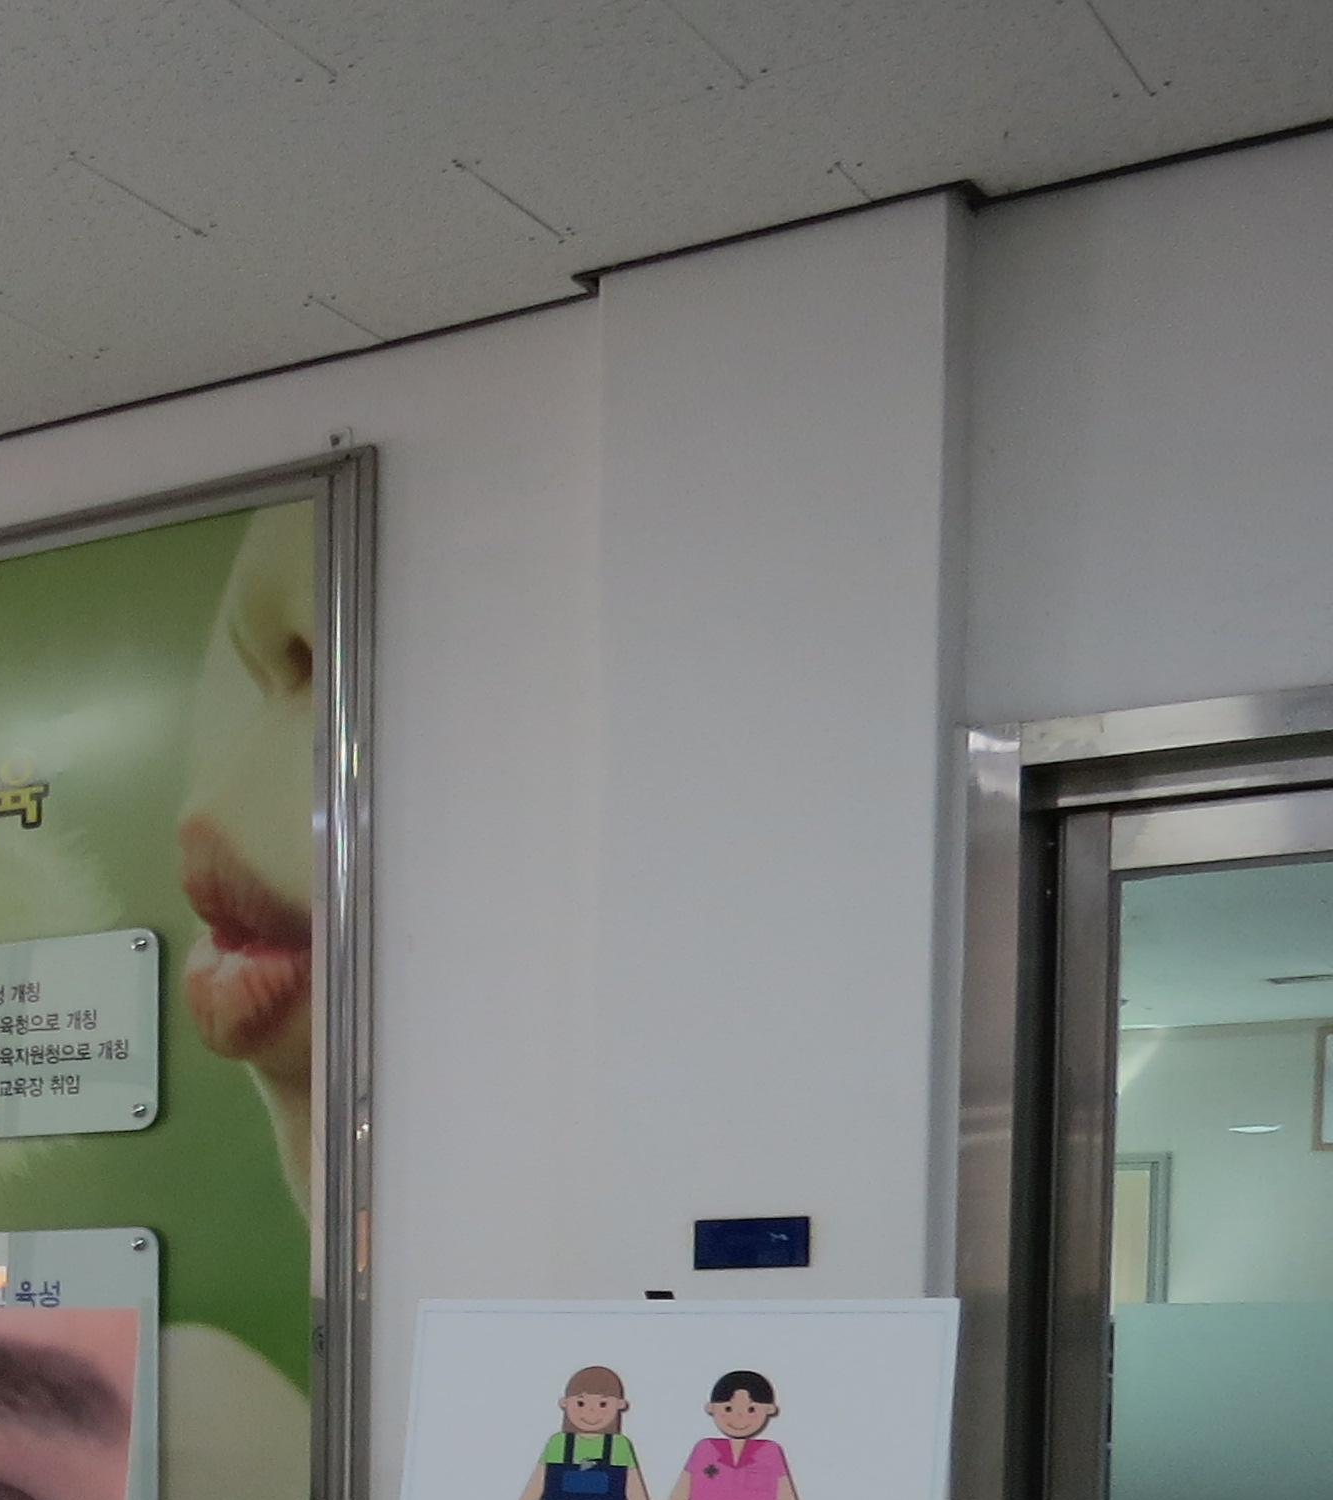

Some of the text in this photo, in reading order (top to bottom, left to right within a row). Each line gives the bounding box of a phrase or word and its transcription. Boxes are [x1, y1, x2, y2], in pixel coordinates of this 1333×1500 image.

[10, 981, 41, 1003] 개칭
[65, 1008, 97, 1030] 개칭
[97, 1039, 129, 1061] 개칭
[49, 1074, 81, 1095] 취임
[15, 1280, 62, 1308] 육성
